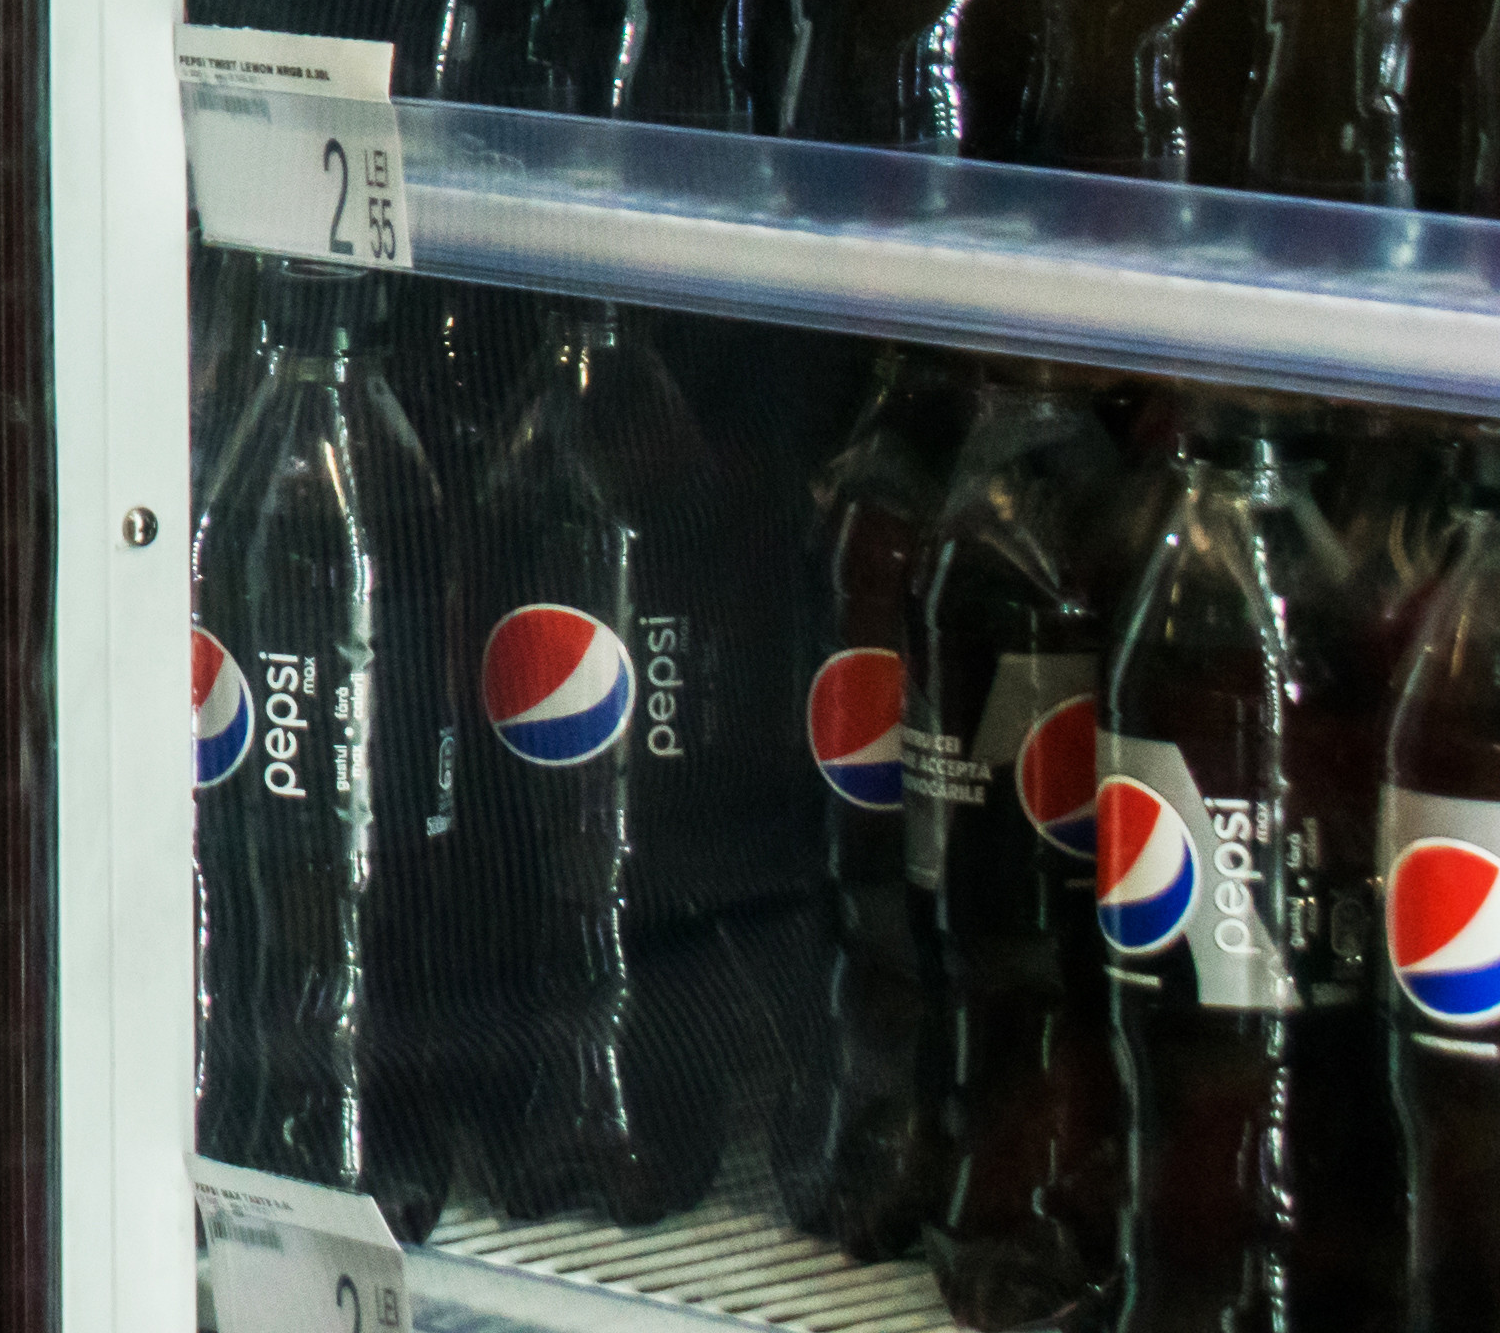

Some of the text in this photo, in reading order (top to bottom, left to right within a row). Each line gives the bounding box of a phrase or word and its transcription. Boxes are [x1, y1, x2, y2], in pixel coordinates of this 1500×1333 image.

[179, 55, 206, 68] PEPSI
[240, 61, 274, 75] LEMON
[322, 137, 388, 255] 2 LEI
[368, 196, 397, 261] 55
[302, 655, 316, 696] max
[639, 614, 685, 759] pepsi
[259, 650, 308, 799] pepsi
[335, 743, 349, 793] gustul
[1203, 796, 1265, 956] pepsi
[336, 1273, 401, 1333] 2 LEI
